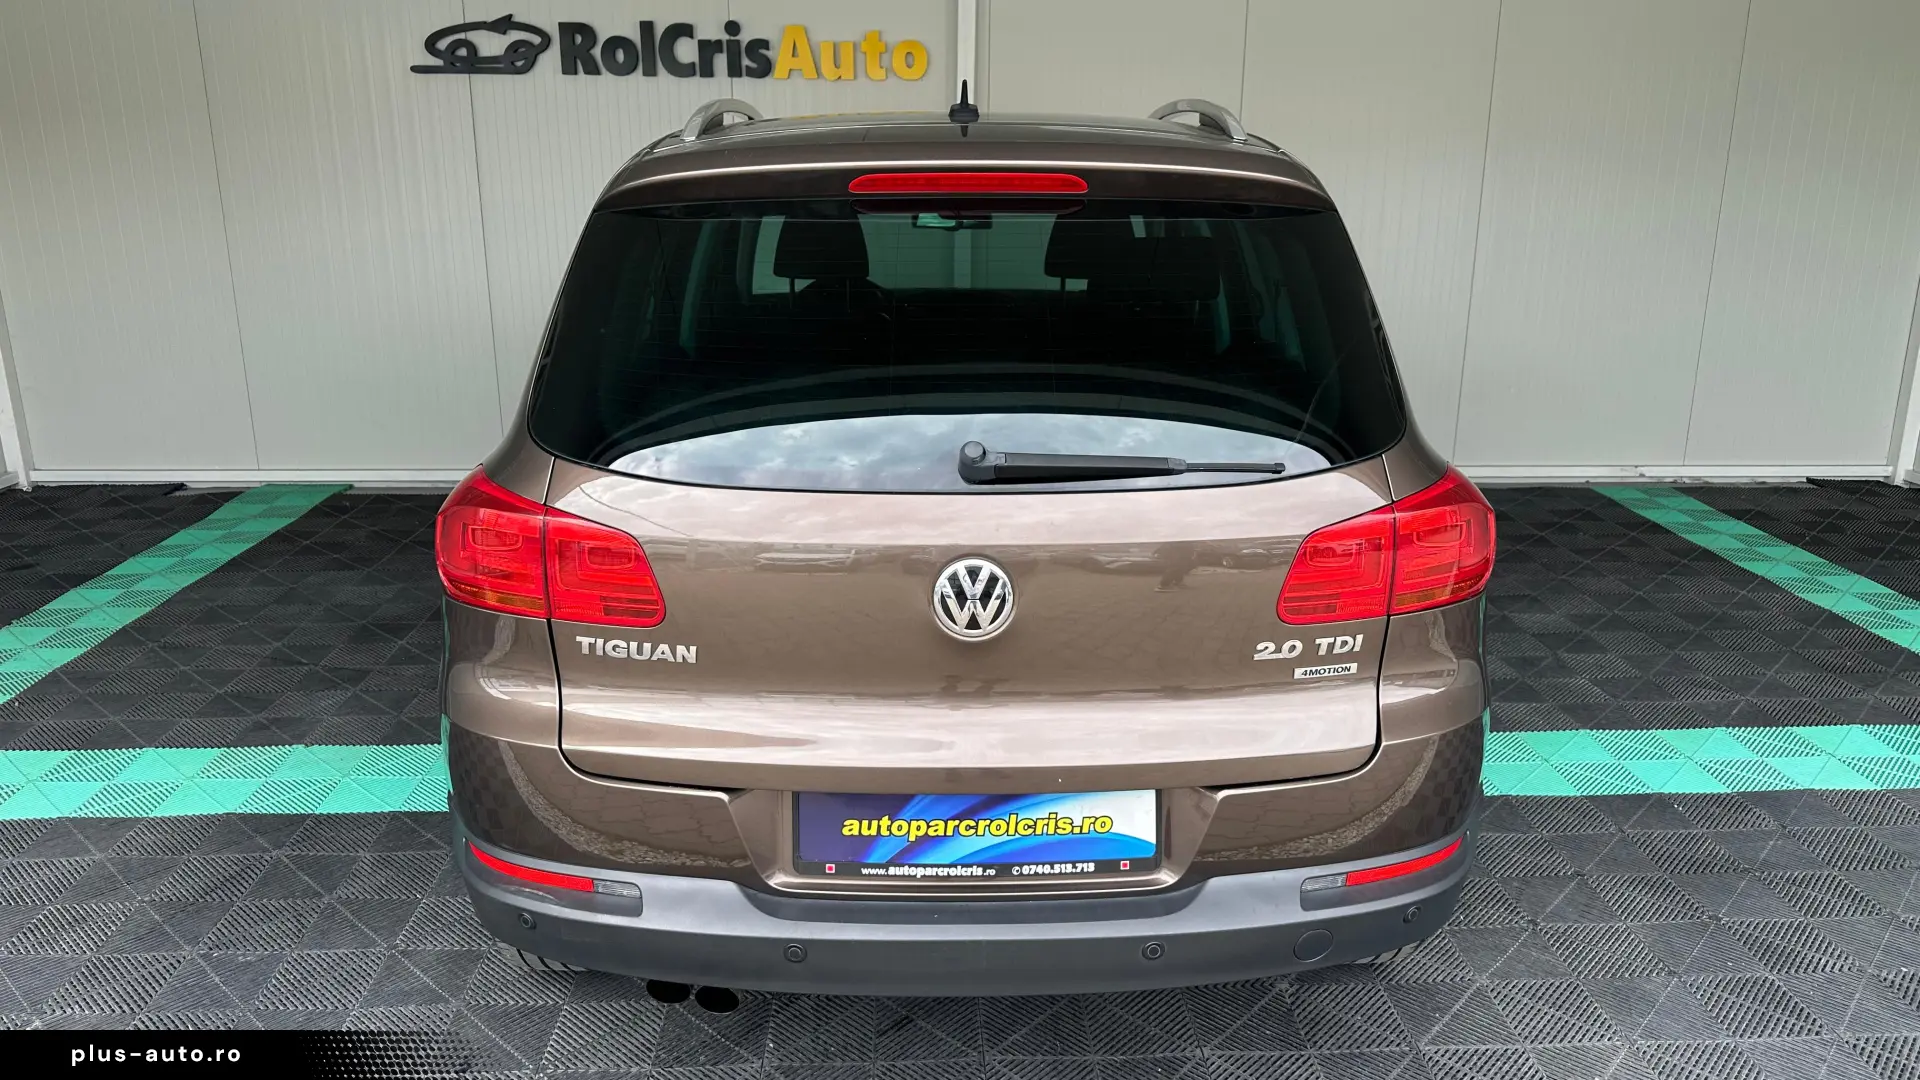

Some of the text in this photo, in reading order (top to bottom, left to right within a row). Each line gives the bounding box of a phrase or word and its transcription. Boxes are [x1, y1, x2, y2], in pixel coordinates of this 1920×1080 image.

[576, 636, 698, 664] TIGUAN
[1315, 634, 1364, 656] TDI
[1301, 666, 1351, 677] 4MOTION
[841, 812, 1113, 842] autoparcrolcris.ro
[861, 862, 1095, 878] www.autoparcrolcris.ro 0740.513.713
